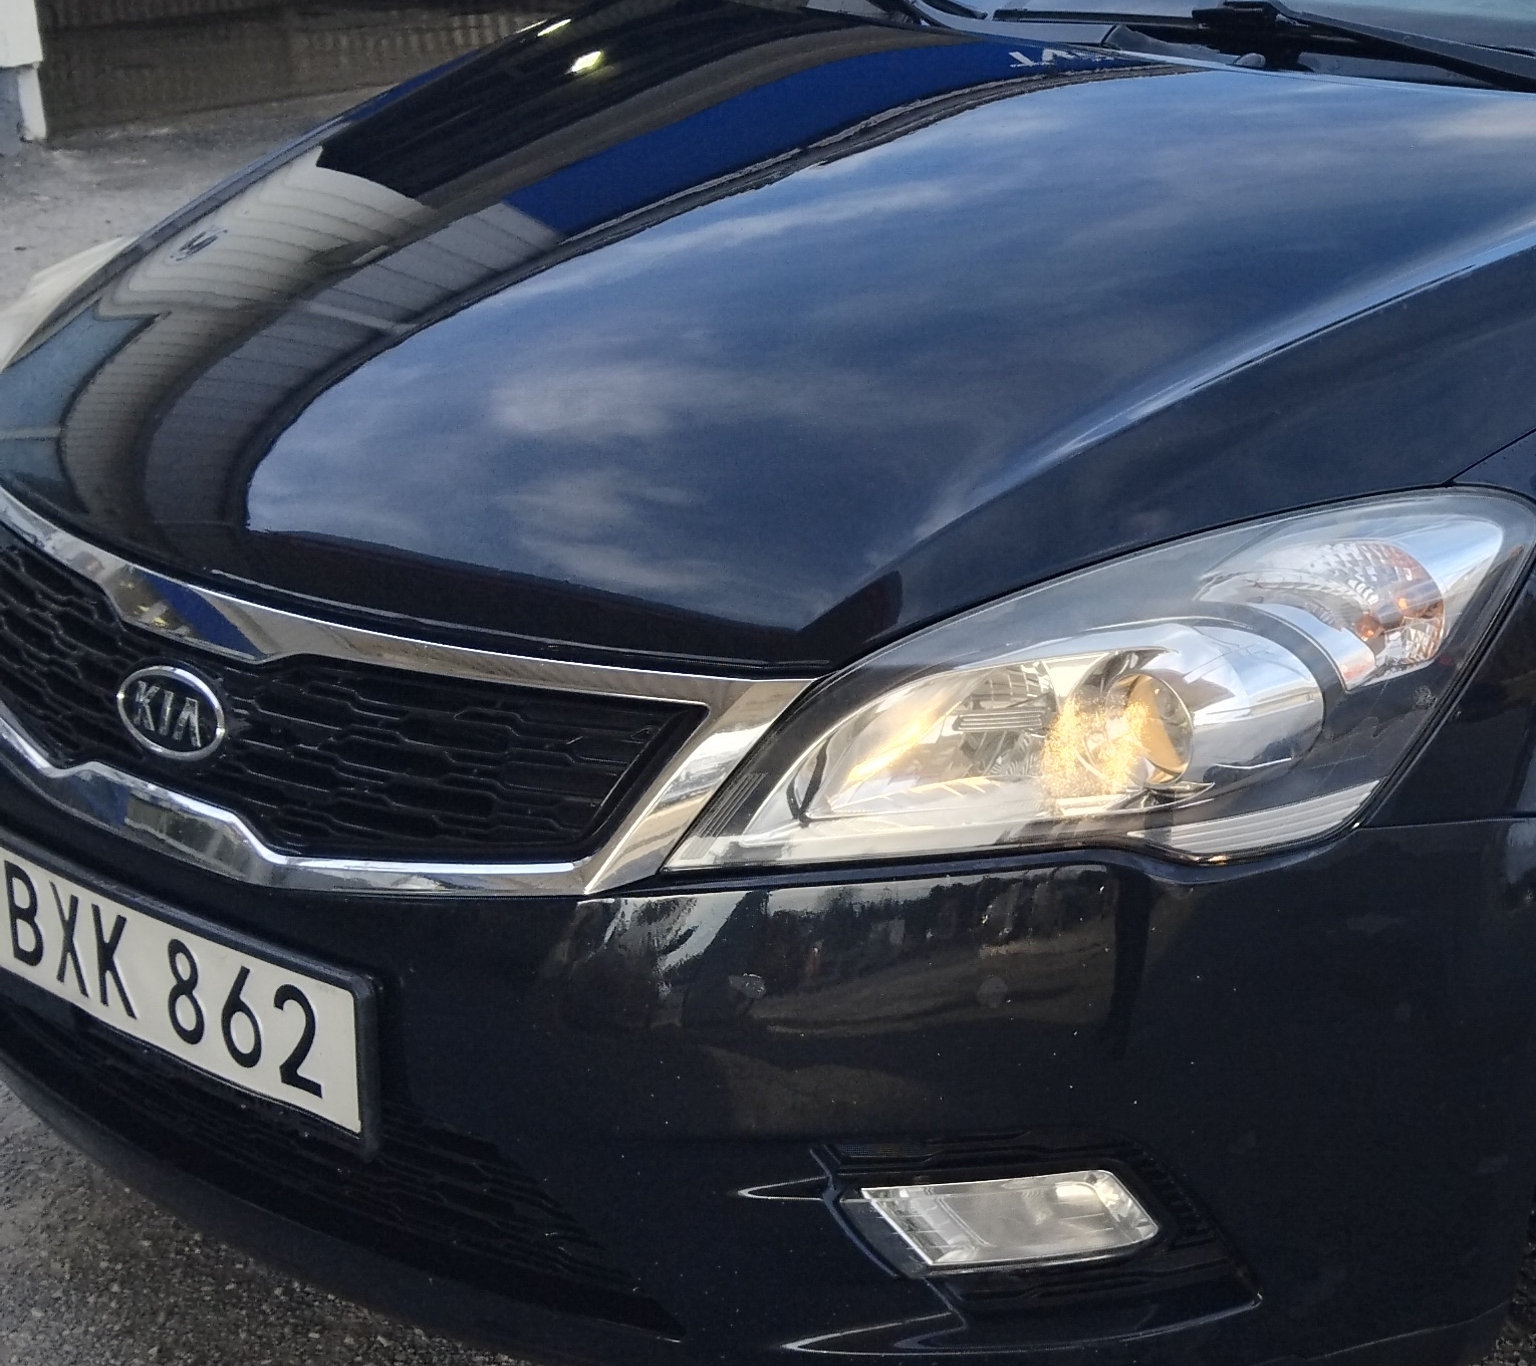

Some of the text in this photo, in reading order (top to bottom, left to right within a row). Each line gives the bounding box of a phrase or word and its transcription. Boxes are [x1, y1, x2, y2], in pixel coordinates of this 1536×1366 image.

[132, 679, 202, 748] KIA
[3, 860, 324, 1100] BXK 862
